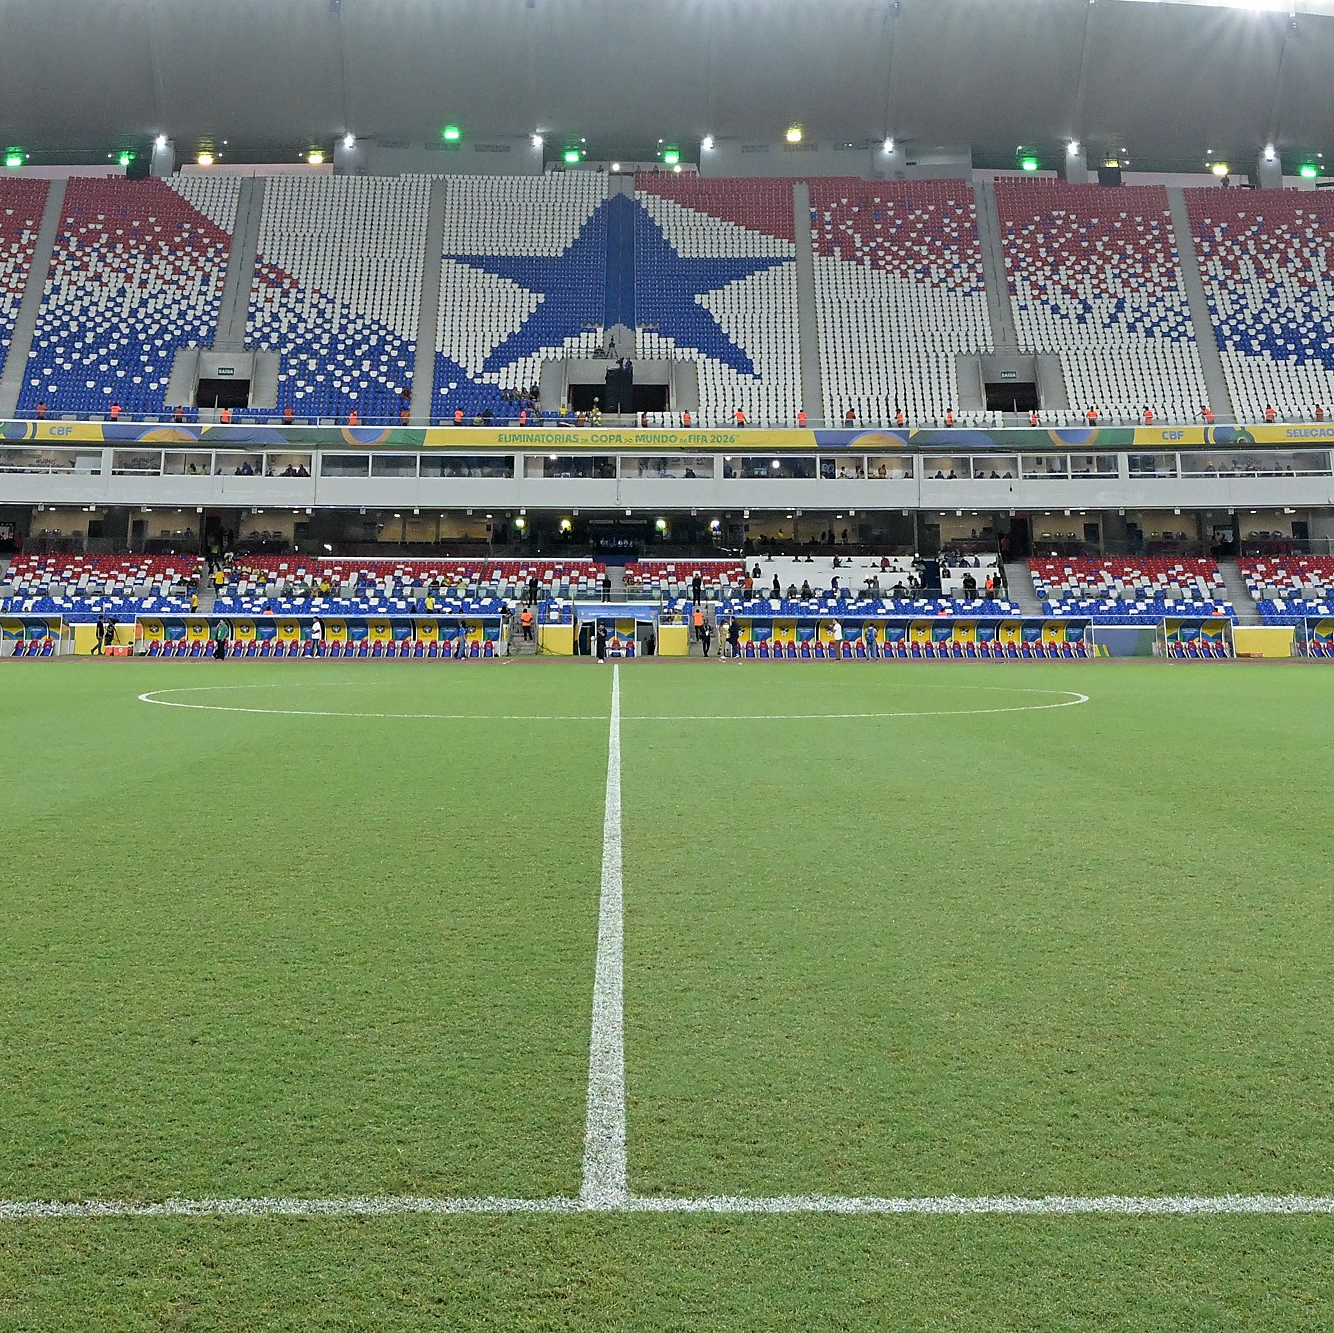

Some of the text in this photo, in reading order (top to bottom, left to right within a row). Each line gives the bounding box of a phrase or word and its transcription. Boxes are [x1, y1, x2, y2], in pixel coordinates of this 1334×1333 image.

[49, 426, 73, 436] CBF
[1162, 430, 1184, 440] CBF
[590, 434, 622, 443] COPA
[635, 434, 677, 443] MUNDO
[688, 434, 707, 443] FIFA
[710, 434, 735, 443] 2026
